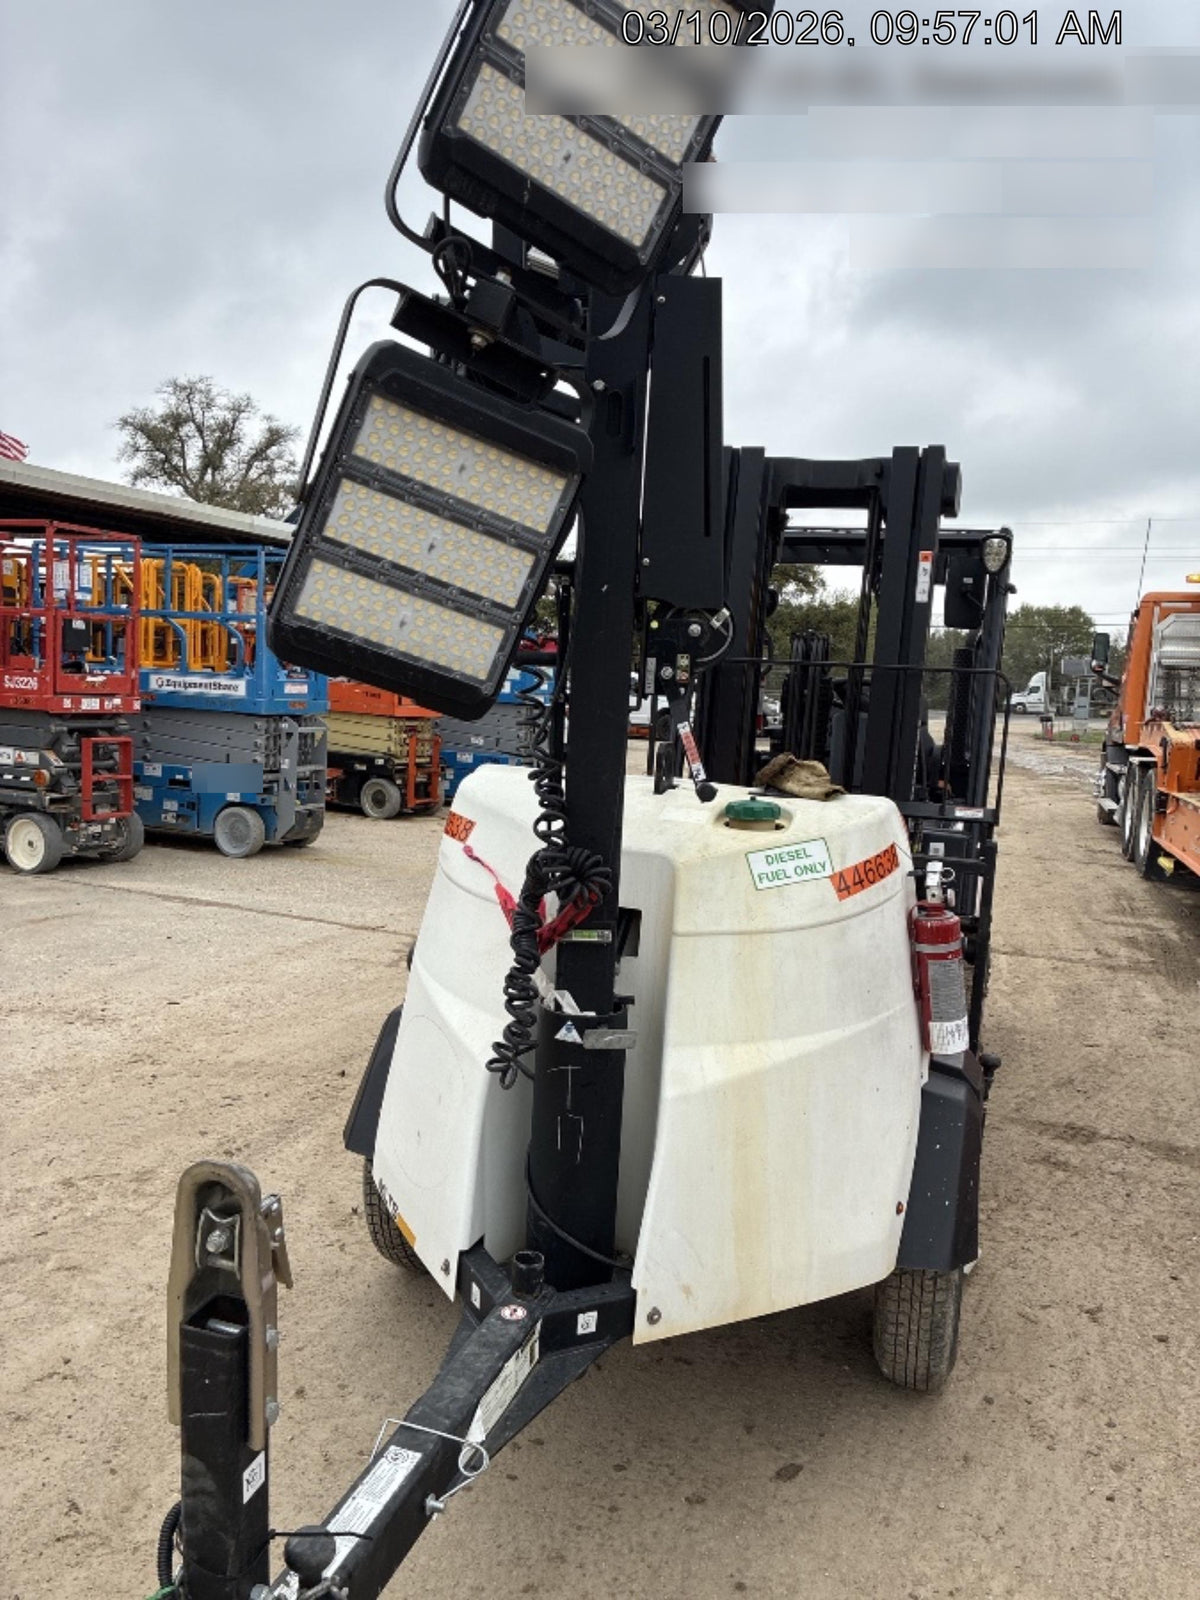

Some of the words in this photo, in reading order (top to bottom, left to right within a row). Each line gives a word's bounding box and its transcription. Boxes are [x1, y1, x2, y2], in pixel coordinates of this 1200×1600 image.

[165, 678, 240, 693] EquipmentShare
[765, 848, 812, 865] DIESEL
[757, 869, 792, 884] FUEL
[794, 861, 827, 877] ONLY
